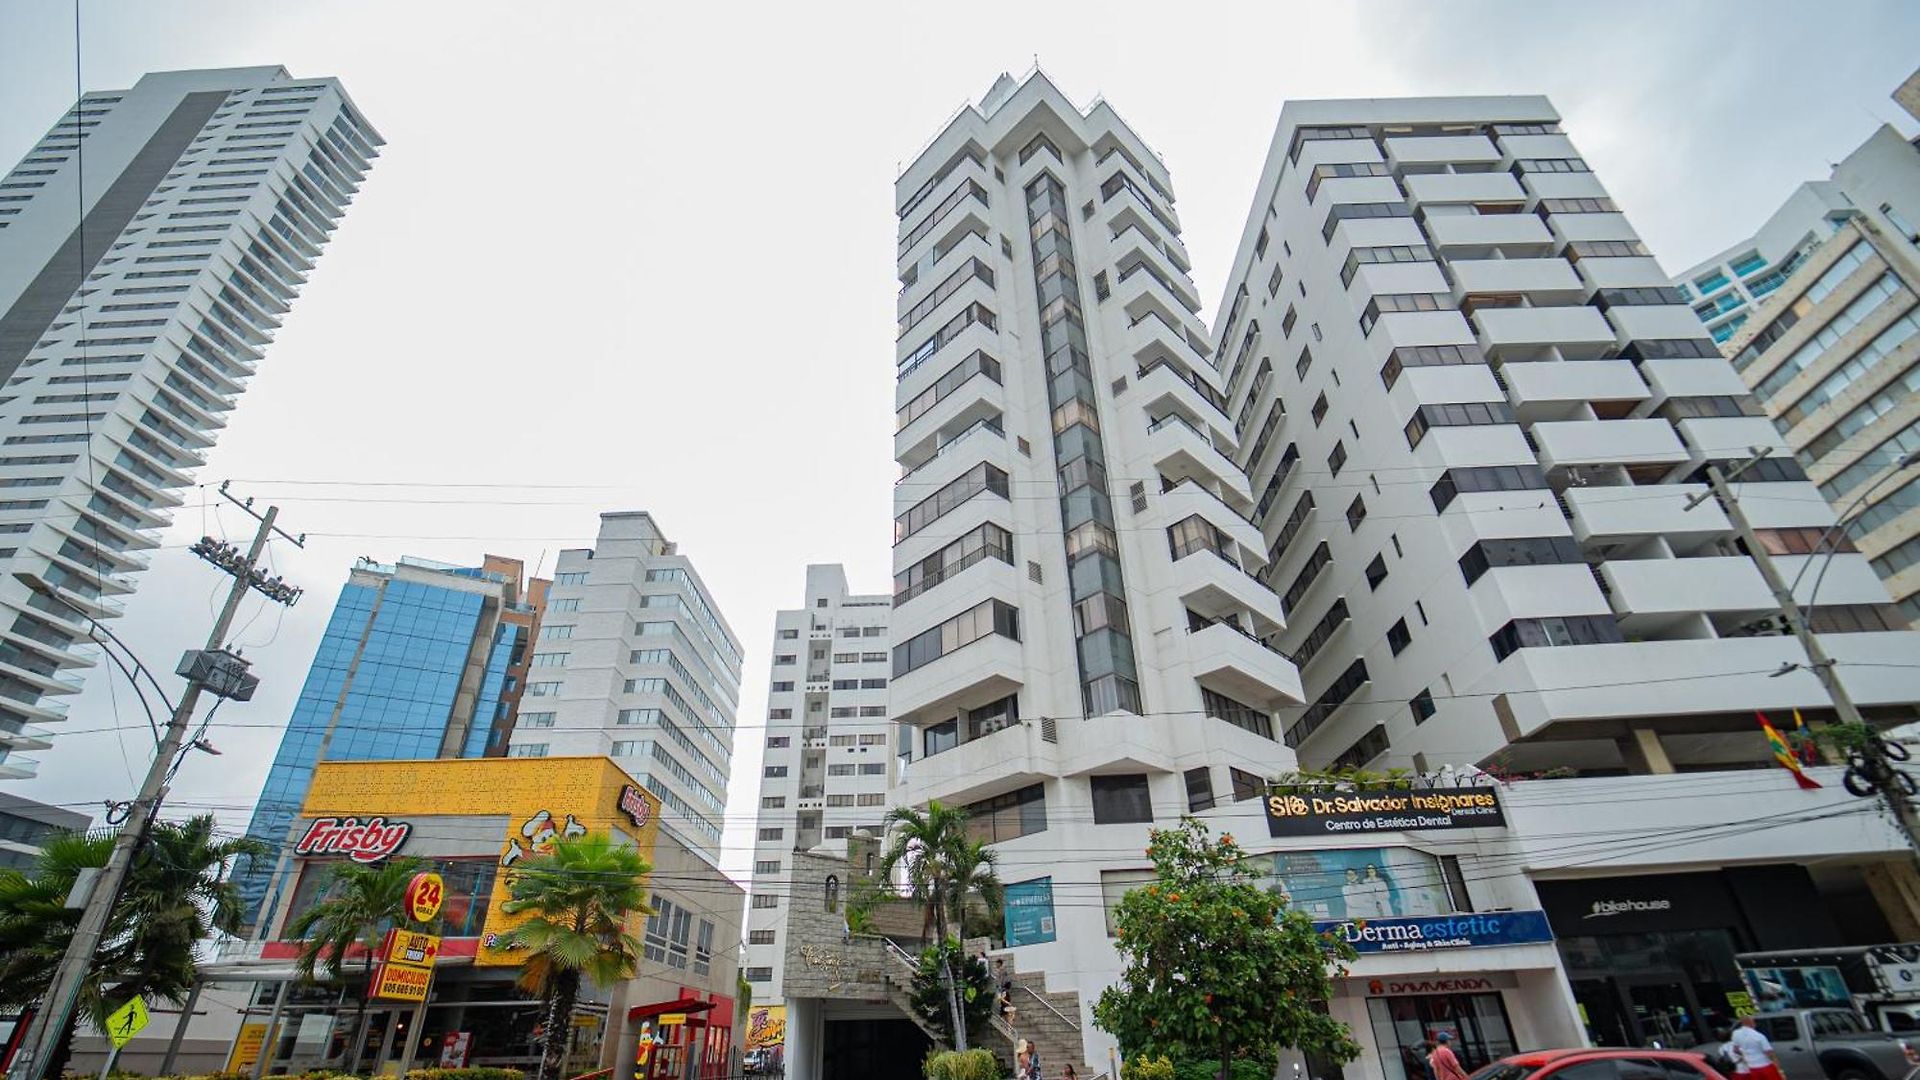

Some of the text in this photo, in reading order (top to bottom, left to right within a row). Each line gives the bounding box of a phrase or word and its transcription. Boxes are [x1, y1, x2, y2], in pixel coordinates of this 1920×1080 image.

[1411, 793, 1495, 813] Insignares
[1325, 820, 1360, 830] Centro
[1362, 819, 1375, 829] de
[1418, 815, 1452, 826] Dental
[295, 817, 409, 863] Frisby
[416, 881, 440, 907] 24
[415, 906, 433, 916] HORAS
[409, 935, 429, 949] AUTO
[386, 968, 429, 986] DOMICILIOS
[1389, 977, 1493, 994] DAVIVIENDA
